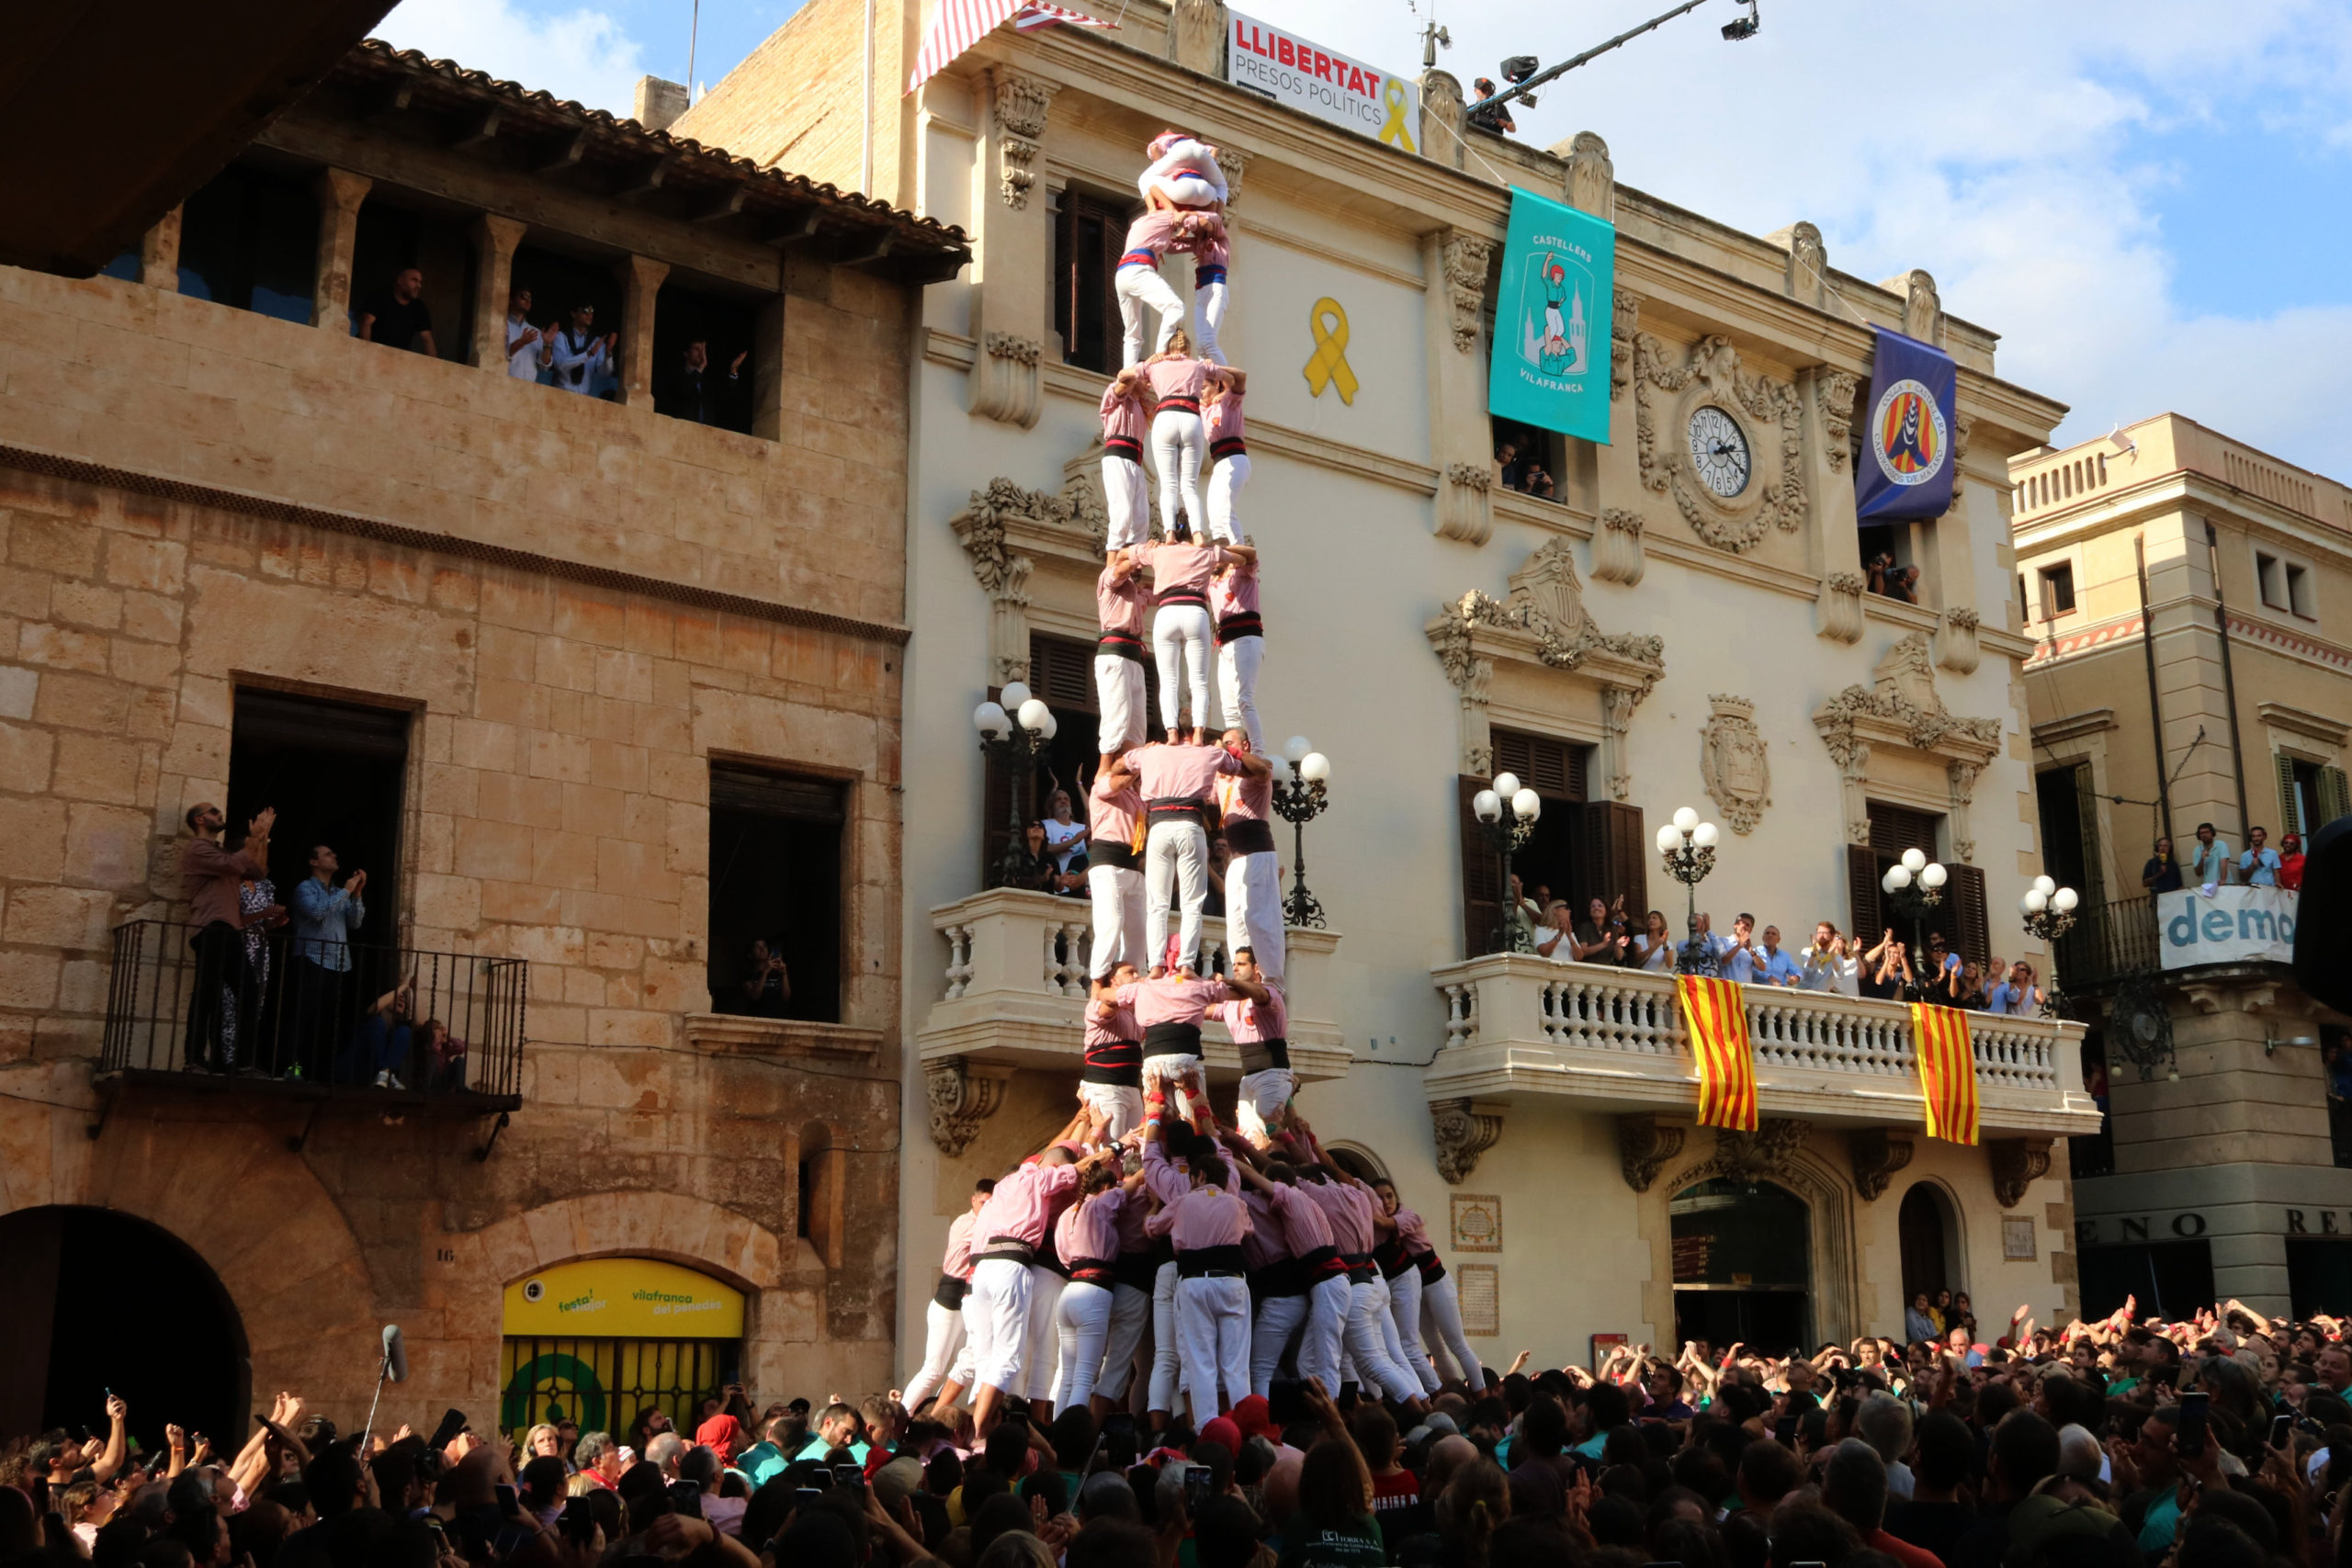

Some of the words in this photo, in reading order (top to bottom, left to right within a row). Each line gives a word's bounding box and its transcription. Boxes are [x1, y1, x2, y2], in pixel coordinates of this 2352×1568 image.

[1236, 19, 1380, 100] LLIBERTAT
[1236, 54, 1302, 96] PRESOS
[1309, 84, 1382, 126] POLÍTICS
[1532, 234, 1592, 264] CASTELLERS
[1519, 367, 1584, 393] VILAFRANCA
[1883, 384, 1903, 406] COLLA
[1701, 415, 1707, 428] 11
[1711, 415, 1719, 428] 12
[1693, 423, 1702, 438] 10
[1691, 439, 1698, 452] 9
[1696, 456, 1702, 468] 8
[1736, 453, 1741, 466] 3
[1706, 470, 1711, 484] 7
[1733, 468, 1738, 479] 4
[1905, 474, 1919, 483] DE
[1716, 477, 1721, 491] 6
[1726, 478, 1733, 491] 5
[2285, 1209, 2352, 1235] RE
[437, 1248, 455, 1261] 16
[559, 1288, 594, 1313] festa!
[632, 1289, 693, 1303] vilafranca
[652, 1303, 671, 1315] del
